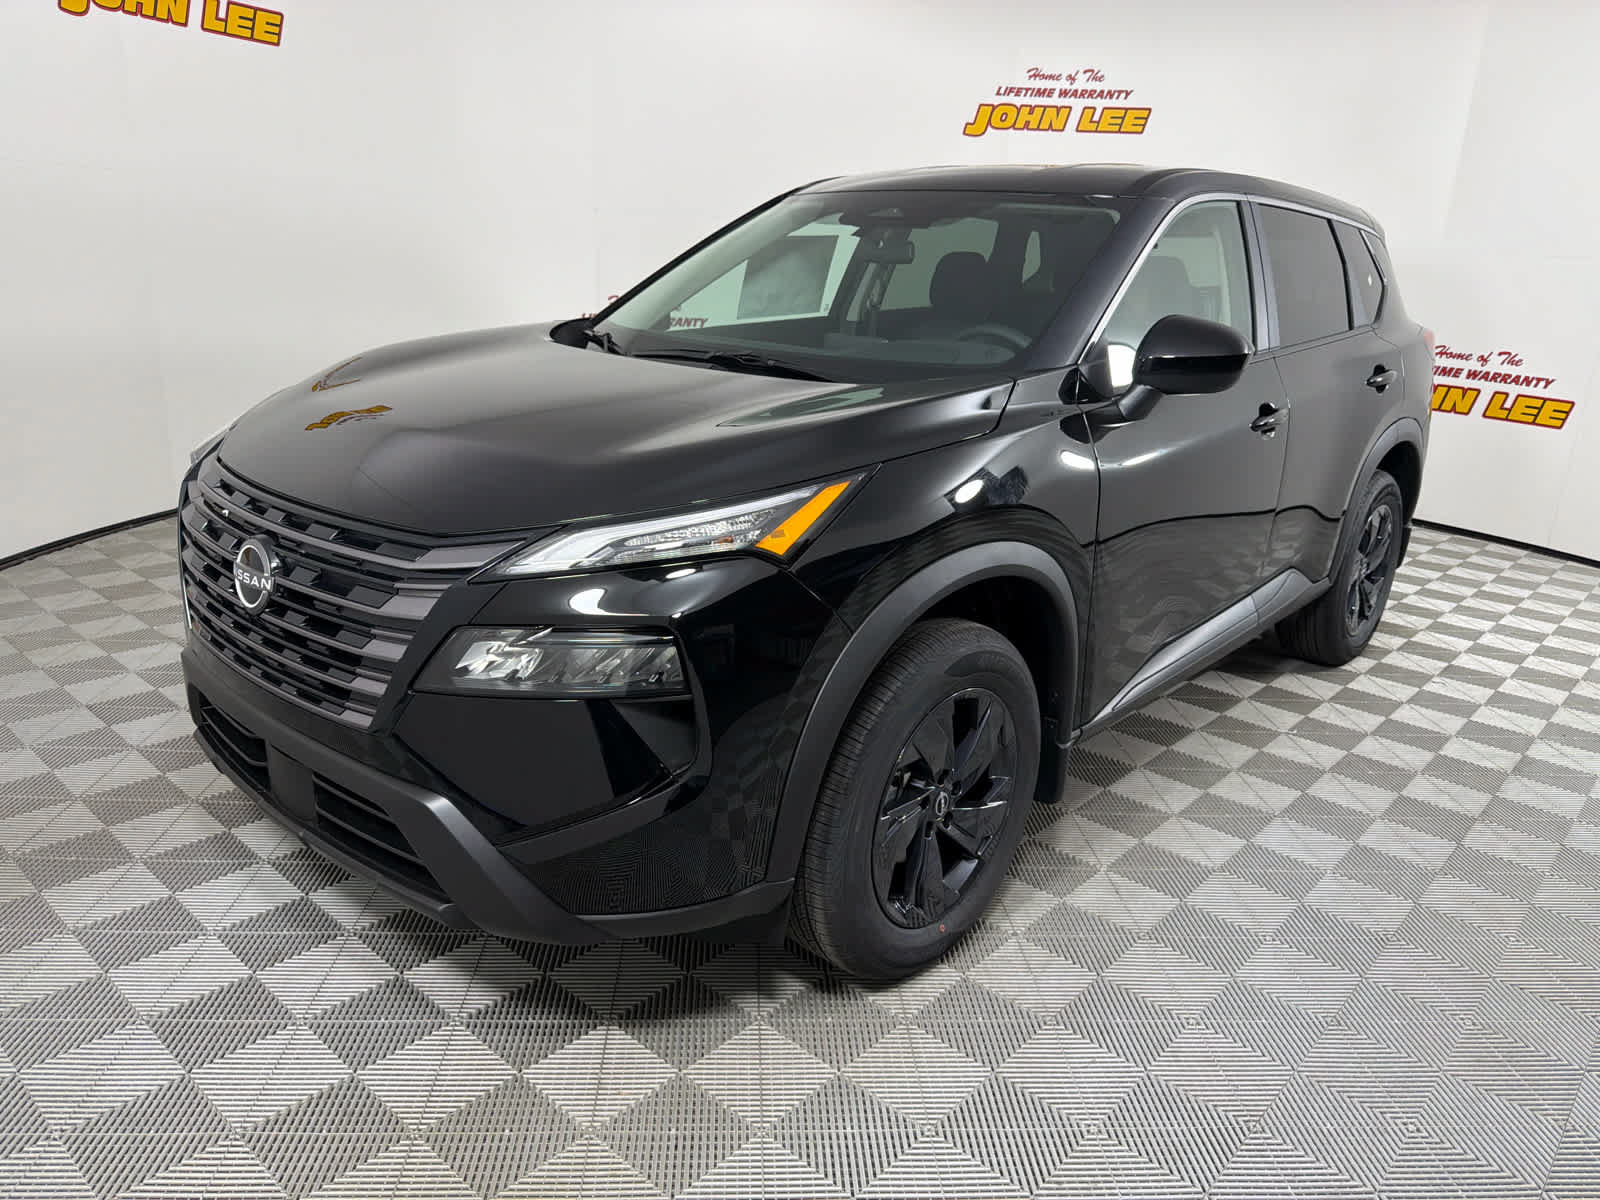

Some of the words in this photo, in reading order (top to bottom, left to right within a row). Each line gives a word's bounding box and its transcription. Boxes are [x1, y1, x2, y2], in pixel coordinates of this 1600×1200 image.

[201, 0, 284, 46] LEE
[1026, 67, 1063, 82] Home
[1065, 70, 1079, 86] of
[1083, 69, 1105, 83] The
[995, 86, 1055, 98] LIFETIME
[1057, 88, 1133, 100] WARRANTY
[963, 103, 1072, 137] JOHN
[1076, 106, 1152, 134] LEE
[1434, 345, 1473, 361] Home
[1476, 352, 1494, 368] of
[1497, 351, 1524, 367] The
[1466, 368, 1556, 389] WARRANTY
[1482, 391, 1575, 429] LEE
[236, 568, 271, 590] SSAN
